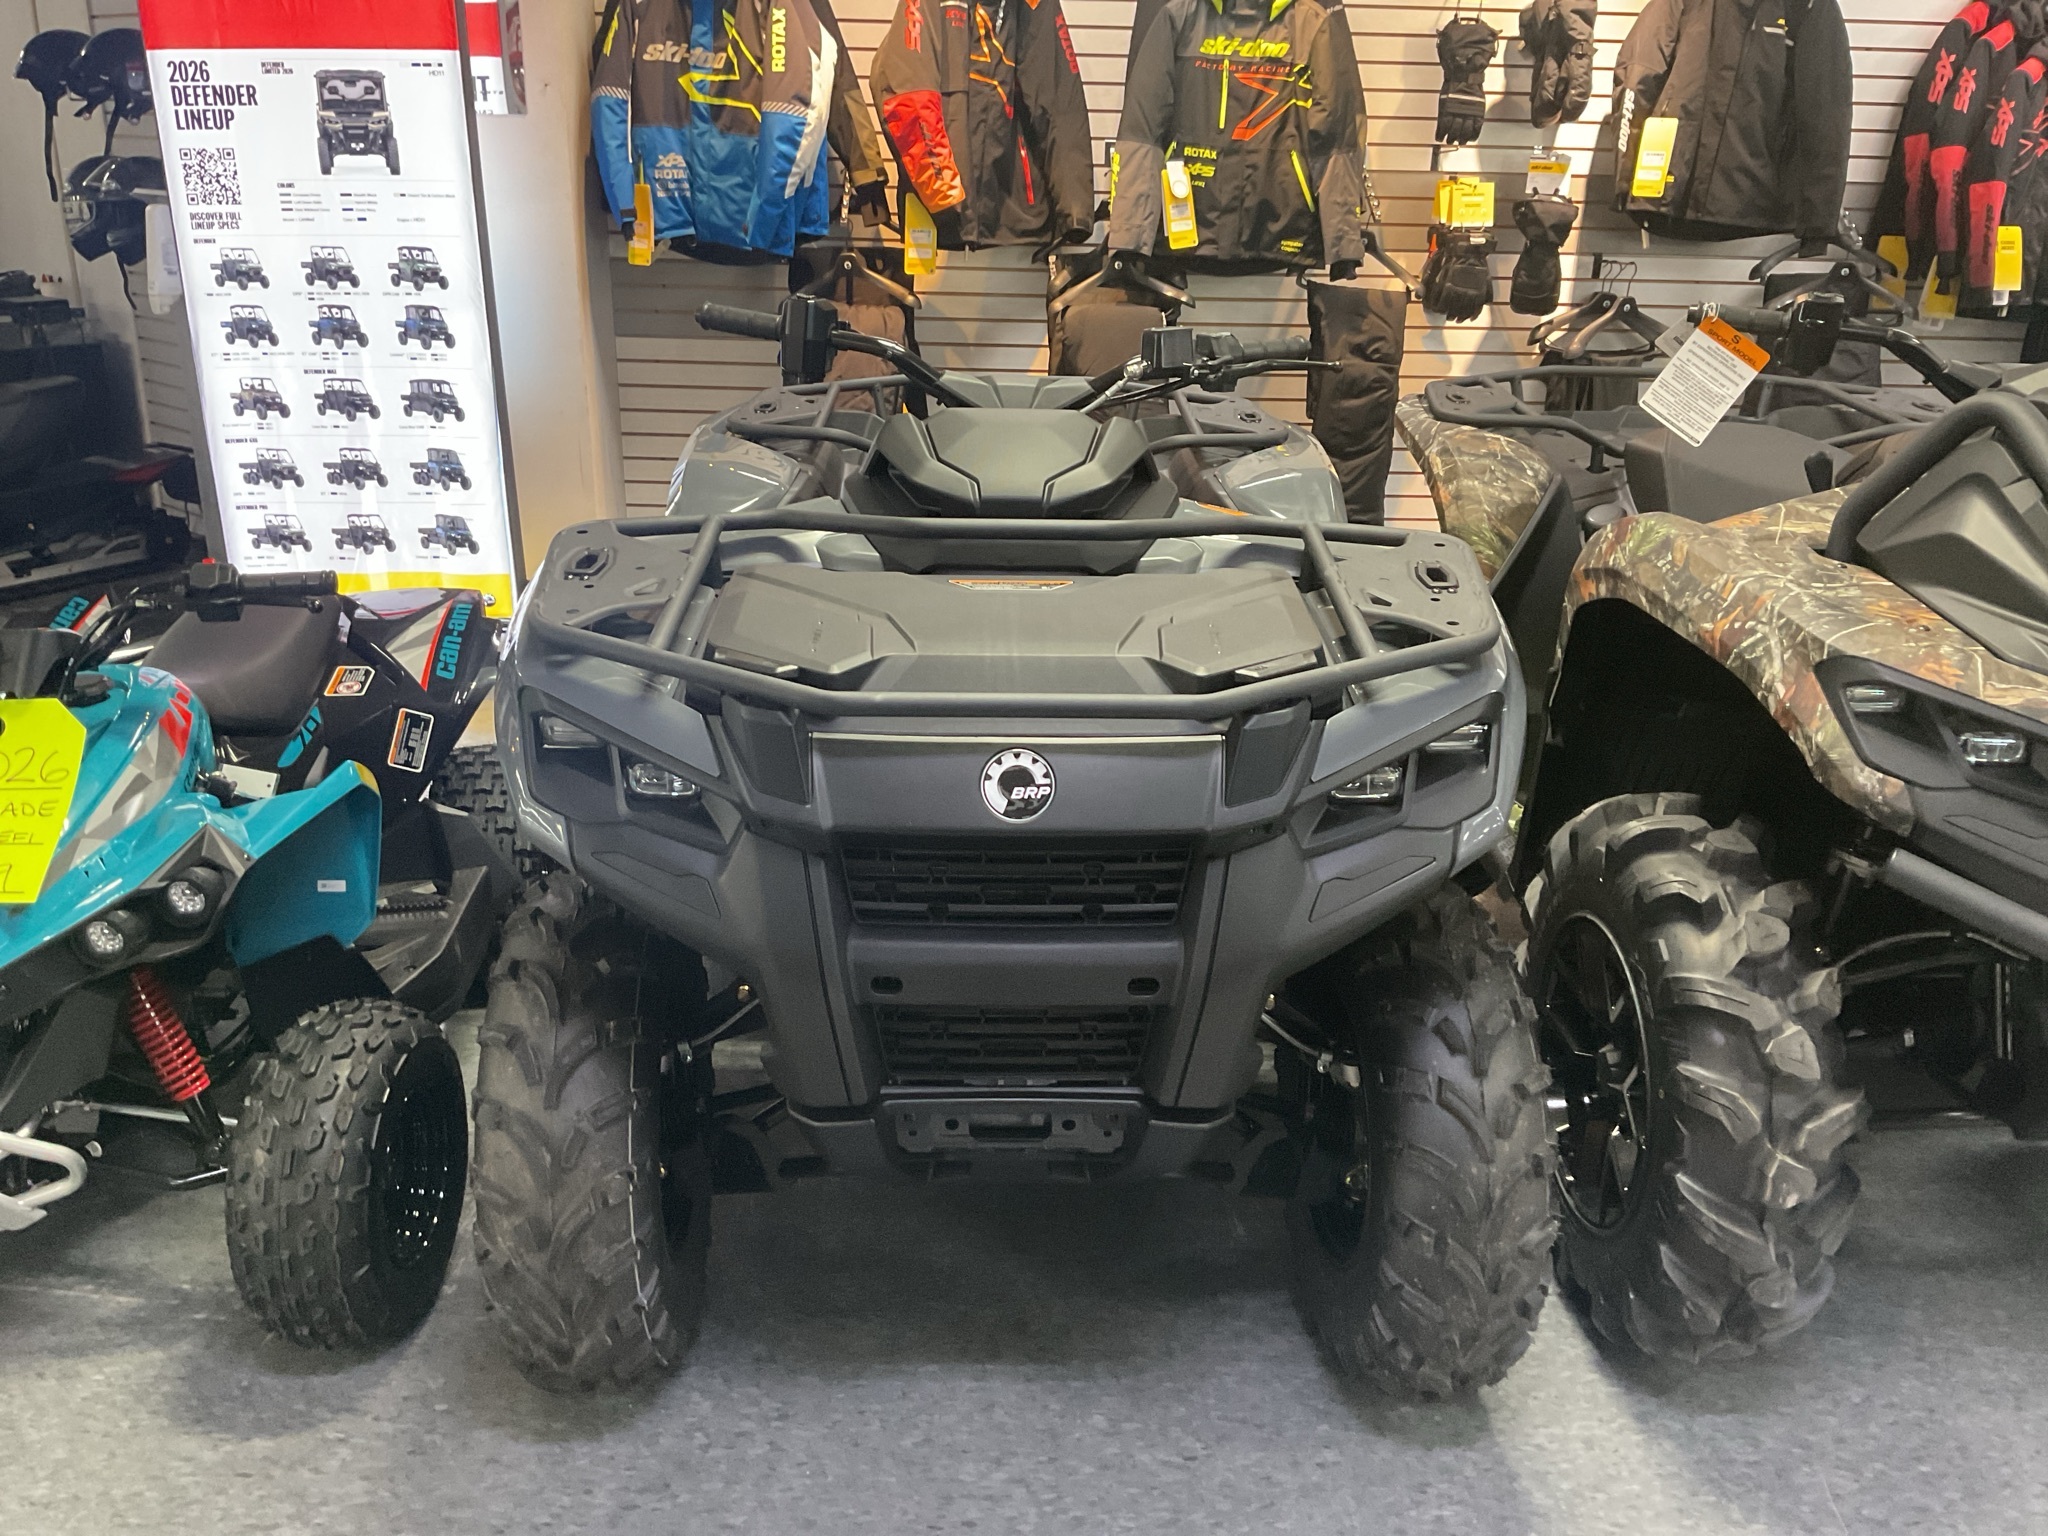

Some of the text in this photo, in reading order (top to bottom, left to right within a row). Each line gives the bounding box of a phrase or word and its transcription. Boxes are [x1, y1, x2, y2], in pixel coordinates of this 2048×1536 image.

[772, 7, 786, 72] ROTAX
[1200, 36, 1290, 57] ski-doo
[167, 60, 210, 82] 2026
[1250, 64, 1291, 73] RACING
[170, 85, 258, 106] DEFENDER
[174, 109, 235, 130] LINEUP
[1618, 88, 1635, 152] ski-doo
[1184, 147, 1217, 159] ROTAX
[189, 212, 242, 220] DISCOVER FULL
[191, 221, 240, 230] LINEUP SPECS
[1707, 329, 1757, 367] SPORT MODEL
[1731, 334, 1741, 345] S
[436, 603, 473, 679] can-am
[1010, 786, 1051, 799] BRP
